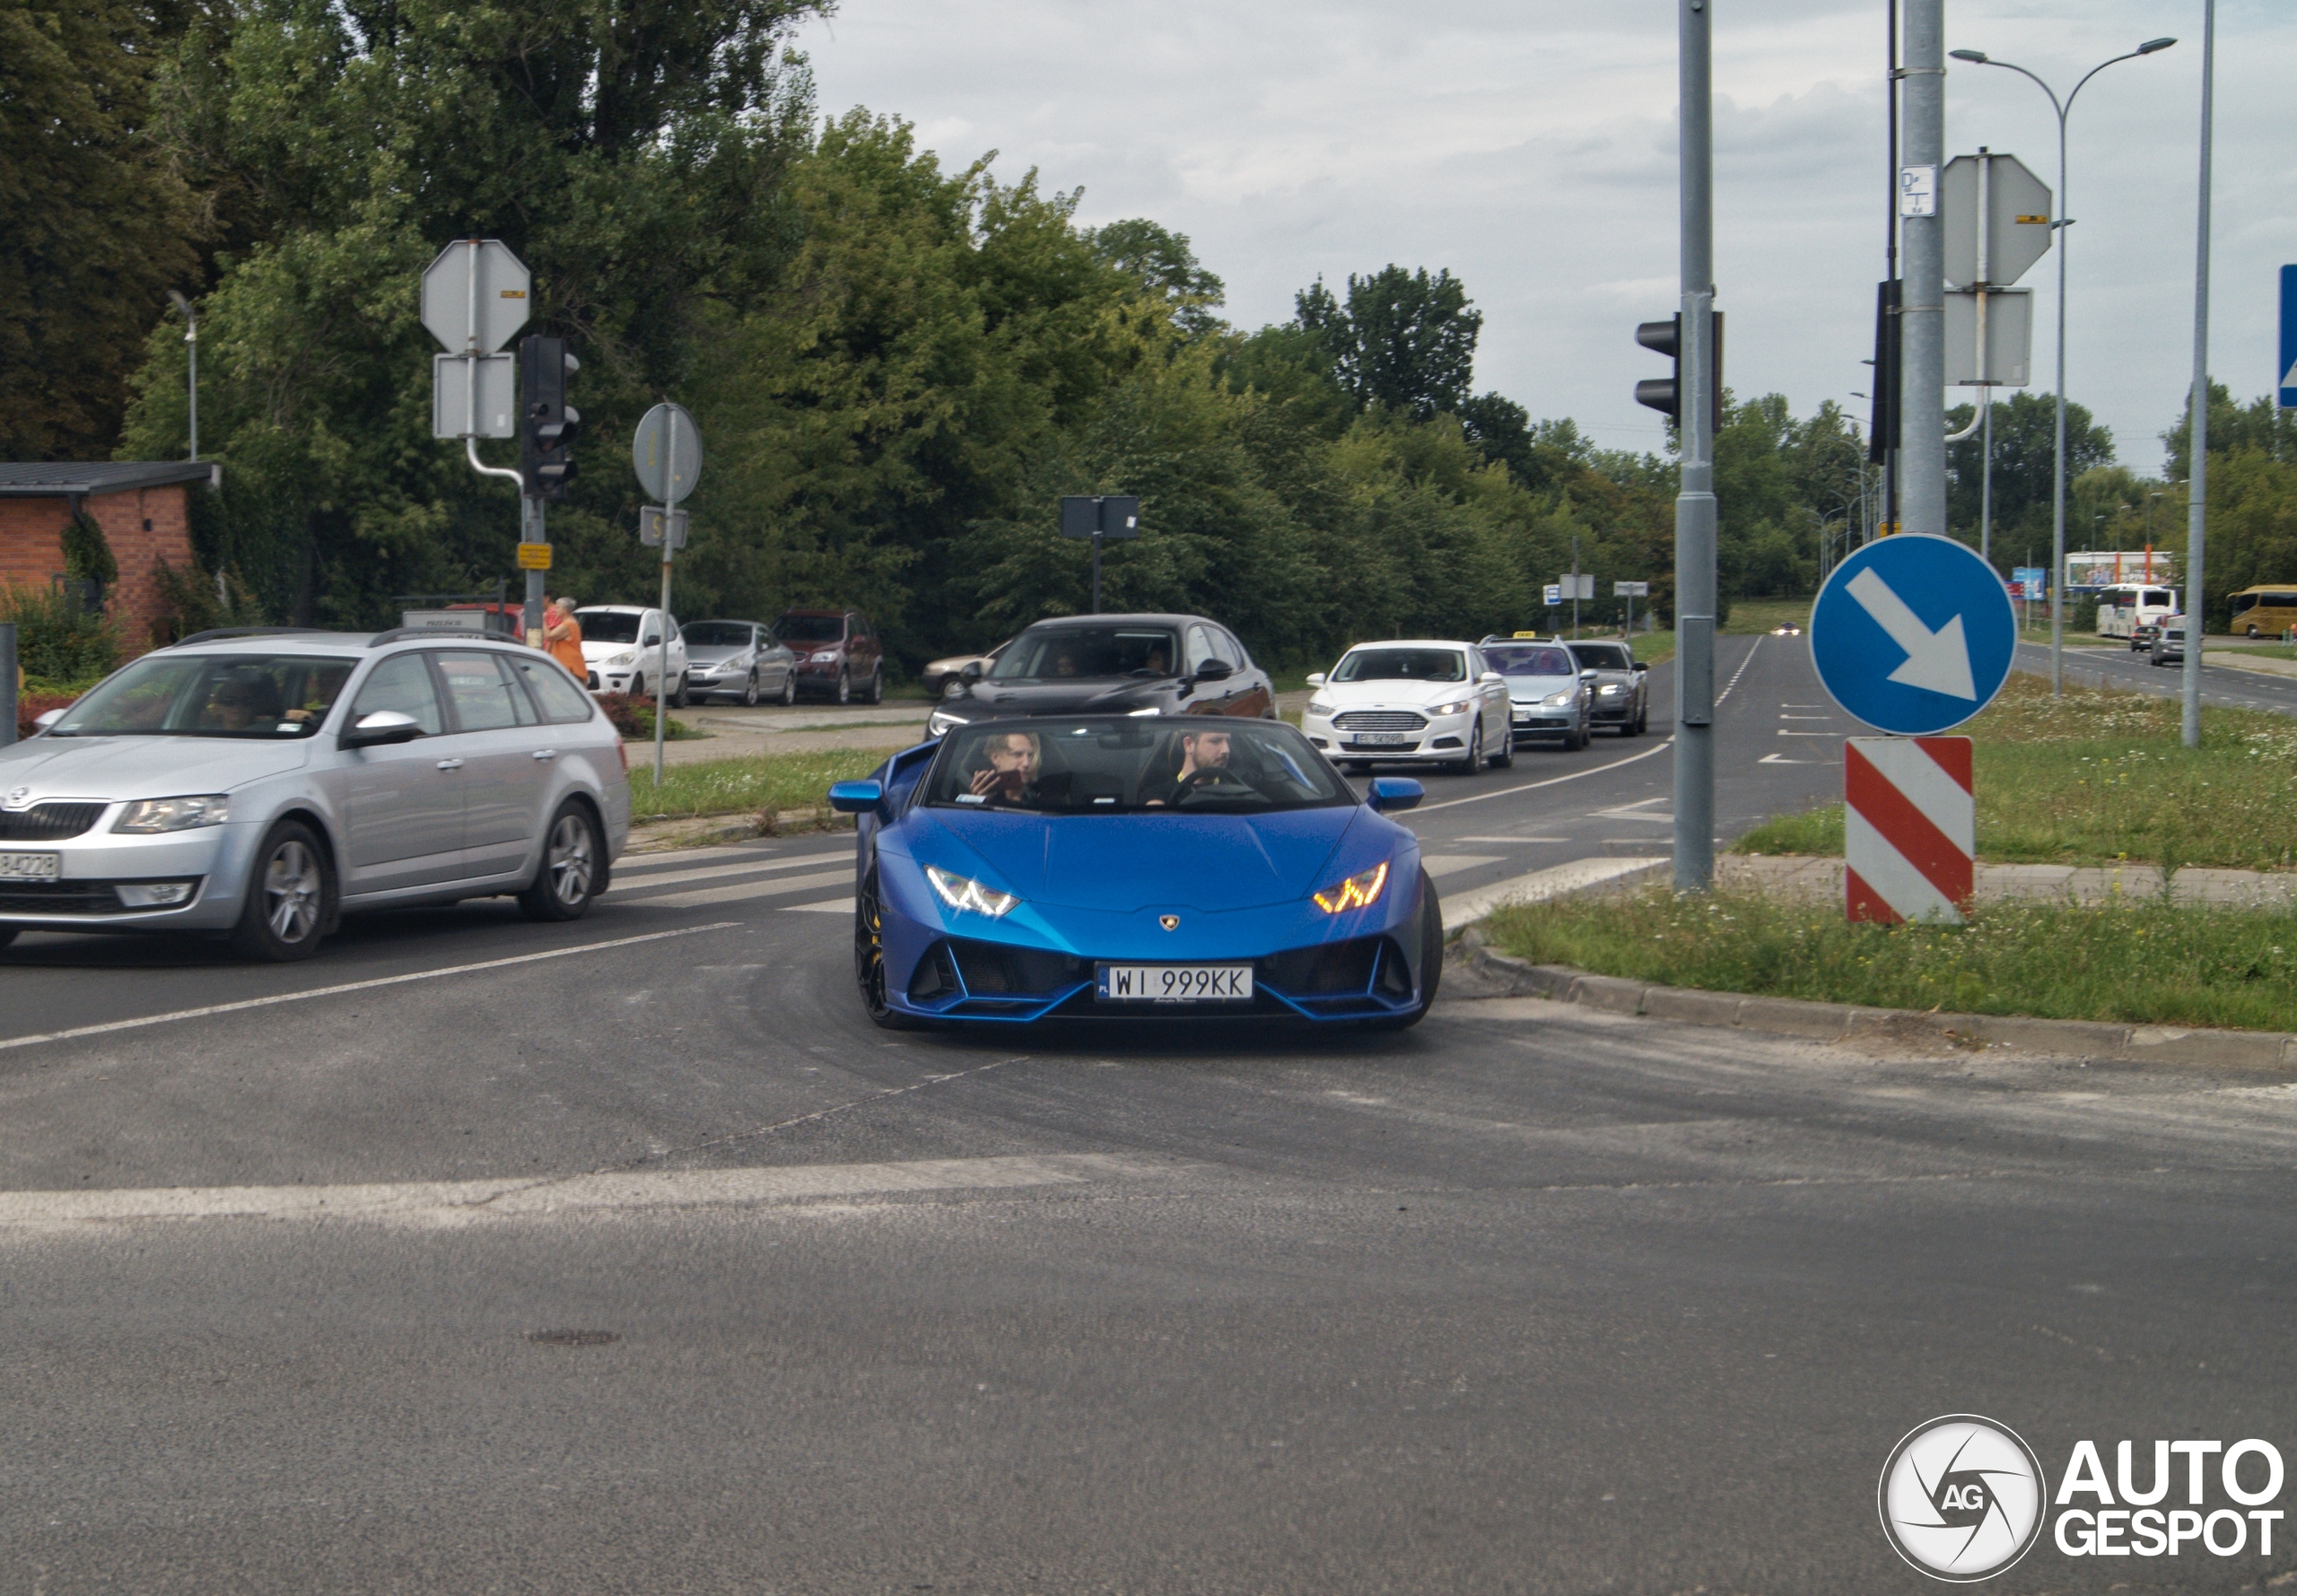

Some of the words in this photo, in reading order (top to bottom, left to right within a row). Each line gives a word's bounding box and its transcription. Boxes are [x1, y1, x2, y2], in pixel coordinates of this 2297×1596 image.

[1099, 985, 1109, 993] PL
[1116, 969, 1145, 996] WI
[1162, 969, 1245, 996] 999KK
